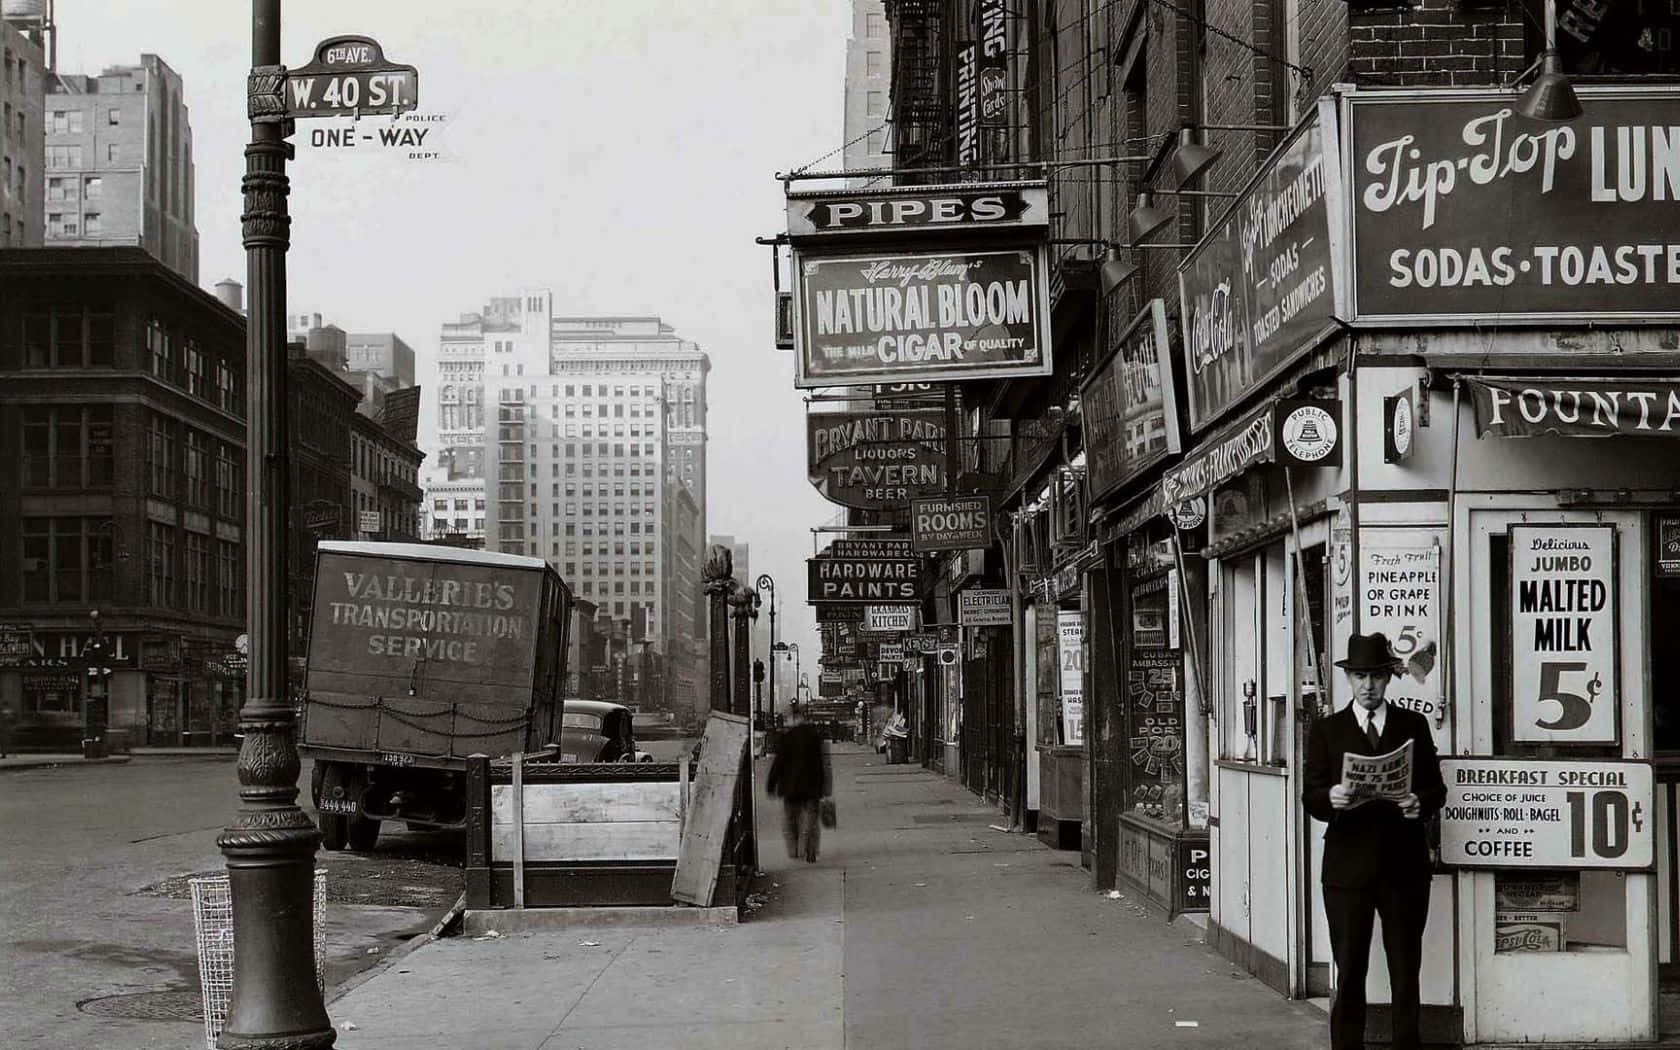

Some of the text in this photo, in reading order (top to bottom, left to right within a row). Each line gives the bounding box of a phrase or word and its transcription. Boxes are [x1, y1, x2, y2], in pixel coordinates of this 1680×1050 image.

[982, 0, 1006, 58] ING
[291, 76, 409, 108] W. 40 ST.
[958, 45, 977, 166] PRINTING
[406, 114, 447, 122] POLICE
[826, 197, 1006, 227] PIPES
[860, 261, 923, 288] Harry
[1270, 242, 1299, 289] SODAS
[816, 279, 1029, 335] NATURAL BLOOM
[1254, 266, 1326, 347] TOASTED SANDWICHES
[878, 332, 964, 363] CIGAR
[964, 340, 976, 350] OF
[978, 338, 1024, 350] QUALITY
[1291, 408, 1328, 421] PUBLIC
[1489, 387, 1680, 431] FOUNTA
[815, 417, 894, 465] BRYANT
[1285, 439, 1335, 460] TELEPHONE
[855, 448, 916, 460] LIQUORS
[831, 464, 937, 487] TAVERN
[865, 488, 907, 500] BEER
[920, 502, 981, 513] FURNISHED
[918, 512, 986, 532] ROOMS
[1530, 538, 1591, 552] Delicious
[1371, 553, 1401, 567] Fresh
[1531, 555, 1592, 572] JUMBO
[820, 563, 918, 578] HARDWARE
[1368, 571, 1436, 584] PINEAPPLE
[823, 582, 915, 598] PAINTS
[1368, 588, 1430, 601] OR GRAPE
[1519, 579, 1606, 614] MALTED
[1370, 605, 1428, 617] DRINK
[330, 602, 522, 639] TRANSPORTATION
[872, 615, 909, 628] KITCHEN
[1534, 618, 1592, 652] MILK
[368, 635, 477, 662] SERVICE
[1456, 768, 1627, 786] BREAKFAST SPECIAL
[1462, 793, 1546, 802] CHOICE OF JUICE
[1496, 827, 1519, 835] AND
[1464, 841, 1533, 857] COFFEE
[1187, 886, 1196, 897] &
